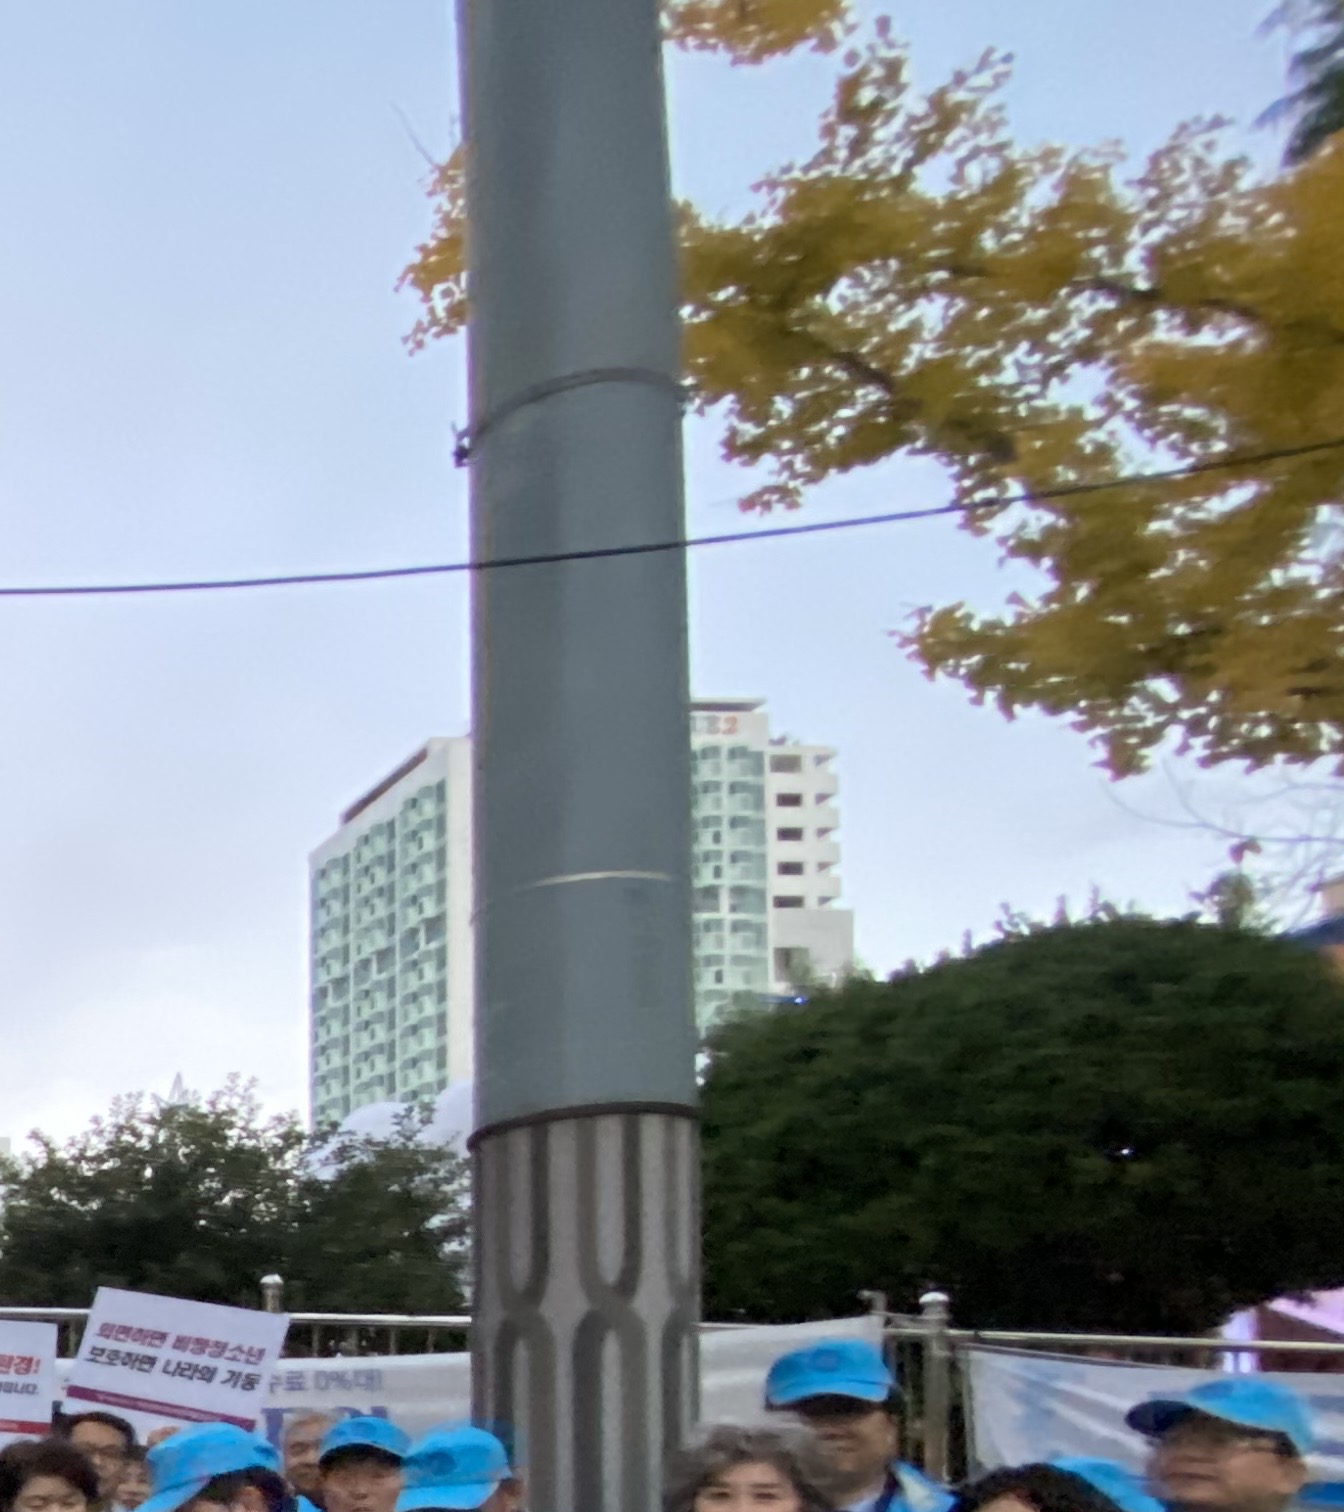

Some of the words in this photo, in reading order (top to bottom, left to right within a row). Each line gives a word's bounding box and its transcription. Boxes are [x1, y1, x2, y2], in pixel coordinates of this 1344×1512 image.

[84, 1346, 158, 1374] 보호하면
[161, 1358, 219, 1384] 나라의
[220, 1369, 263, 1392] 기둥
